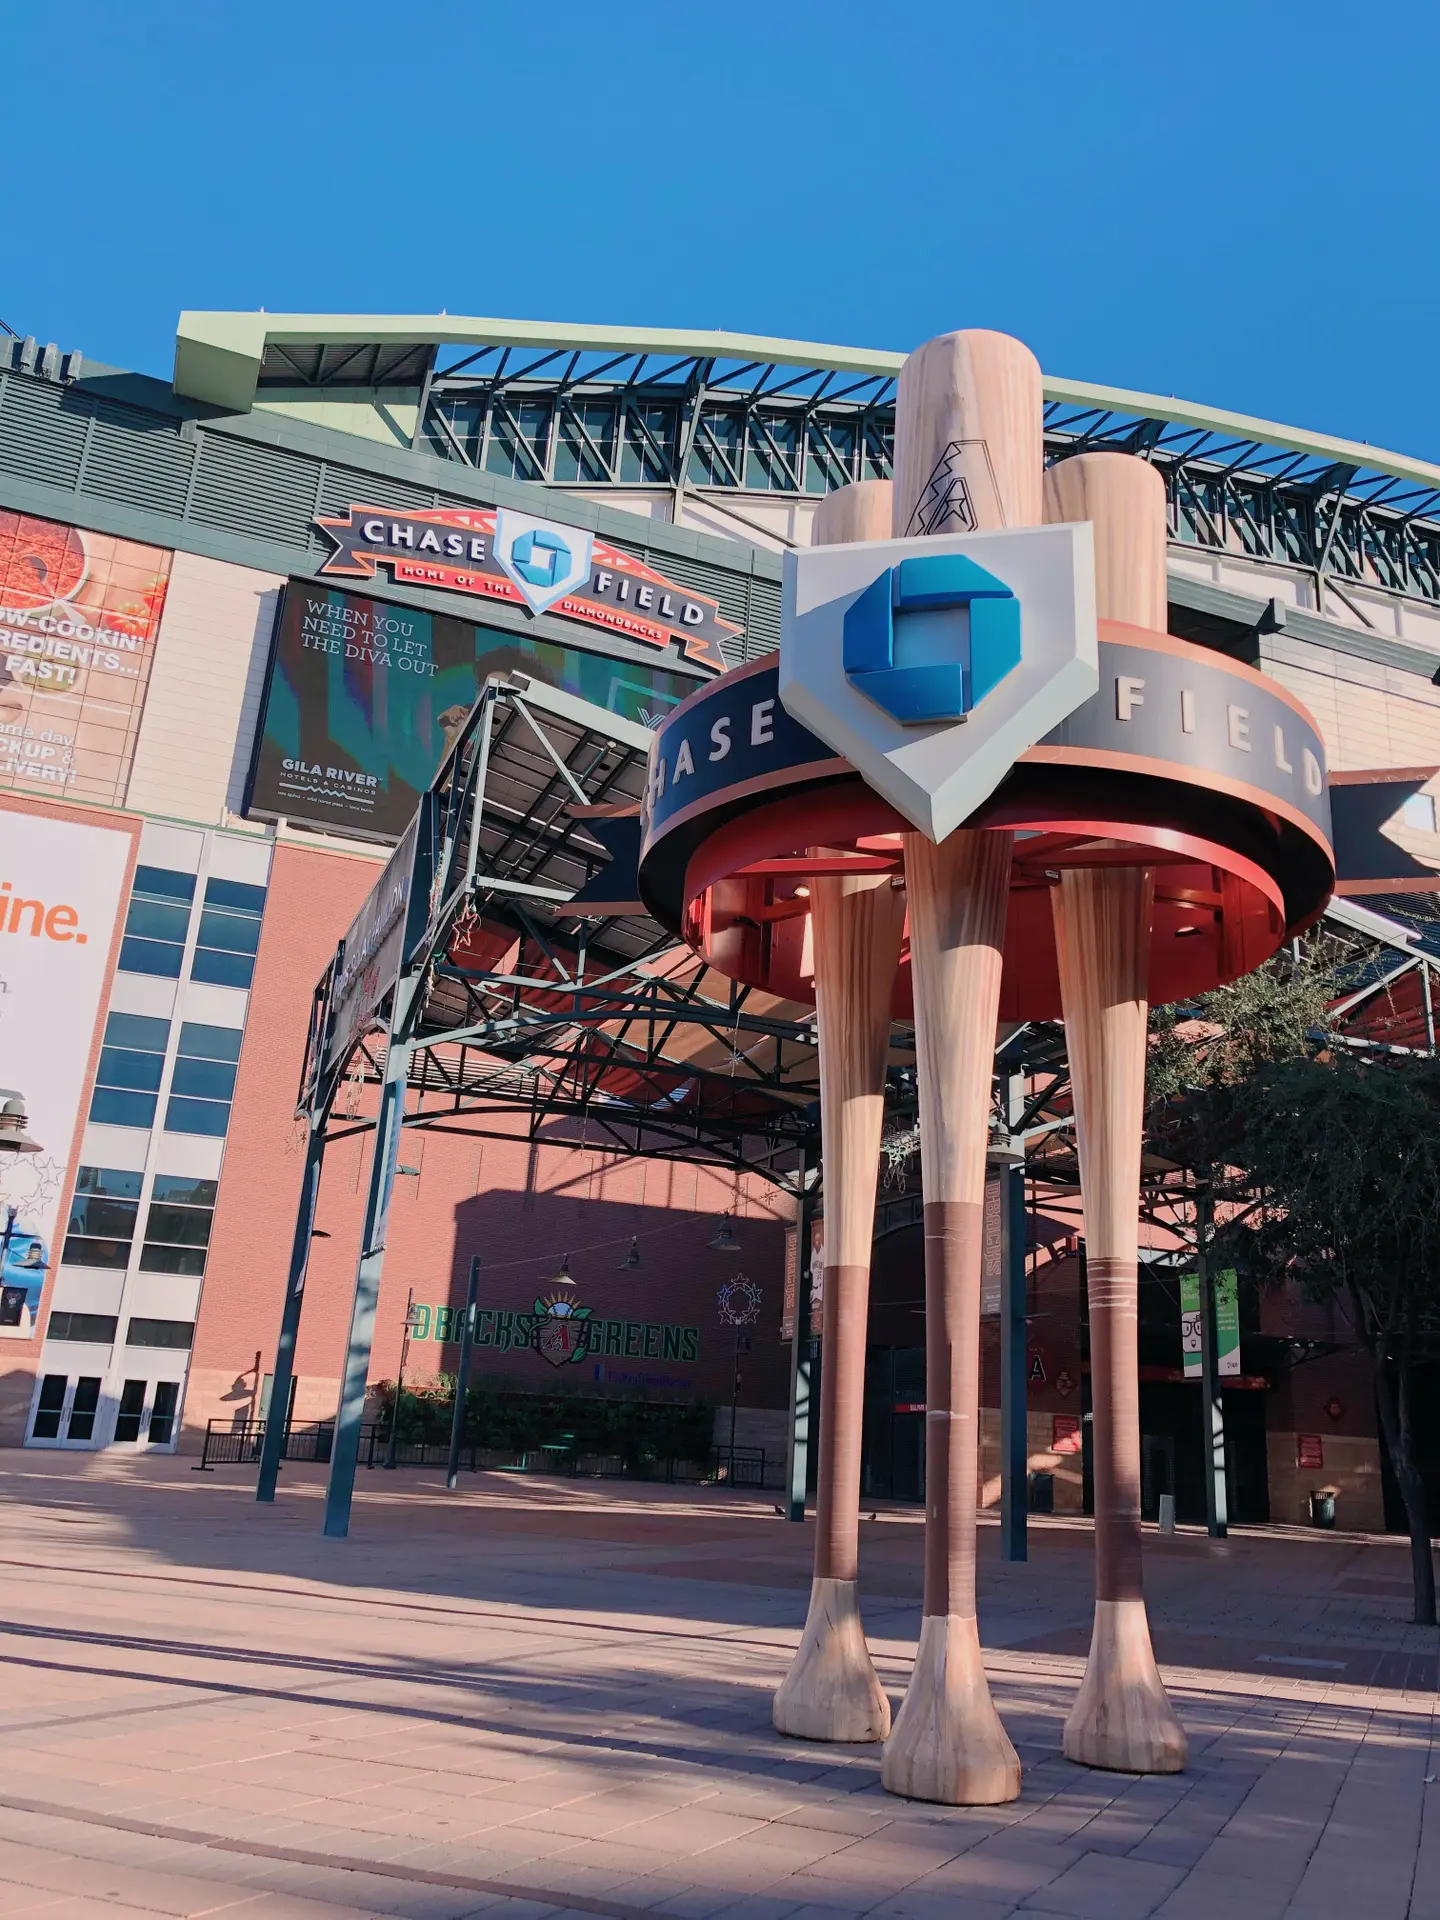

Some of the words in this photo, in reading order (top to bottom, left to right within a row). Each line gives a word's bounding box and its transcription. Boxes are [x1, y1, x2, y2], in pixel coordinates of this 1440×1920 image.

[362, 520, 487, 561] CHASE
[597, 571, 704, 626] FIELD
[306, 599, 369, 626] WHEN
[373, 615, 414, 637] YOU
[404, 565, 445, 580] HOME
[457, 575, 475, 586] OF
[486, 581, 512, 594] THE
[563, 600, 662, 639] DIAMONDBACKS
[301, 632, 341, 655] THE
[345, 643, 393, 667] DIVA
[398, 656, 439, 677] OUT
[303, 616, 356, 640] NEED
[361, 630, 388, 648] TO
[392, 638, 427, 657] LET
[5, 654, 76, 685] FAST!
[61, 749, 75, 765] &
[640, 698, 776, 827] HASE
[1115, 676, 1323, 796] FIELD
[280, 771, 318, 784] HOTELS
[333, 783, 377, 796] CASINOS
[282, 758, 322, 777] GILA
[326, 766, 379, 788] RIVER
[588, 1318, 699, 1363] GREENS
[1028, 1354, 1047, 1382] A
